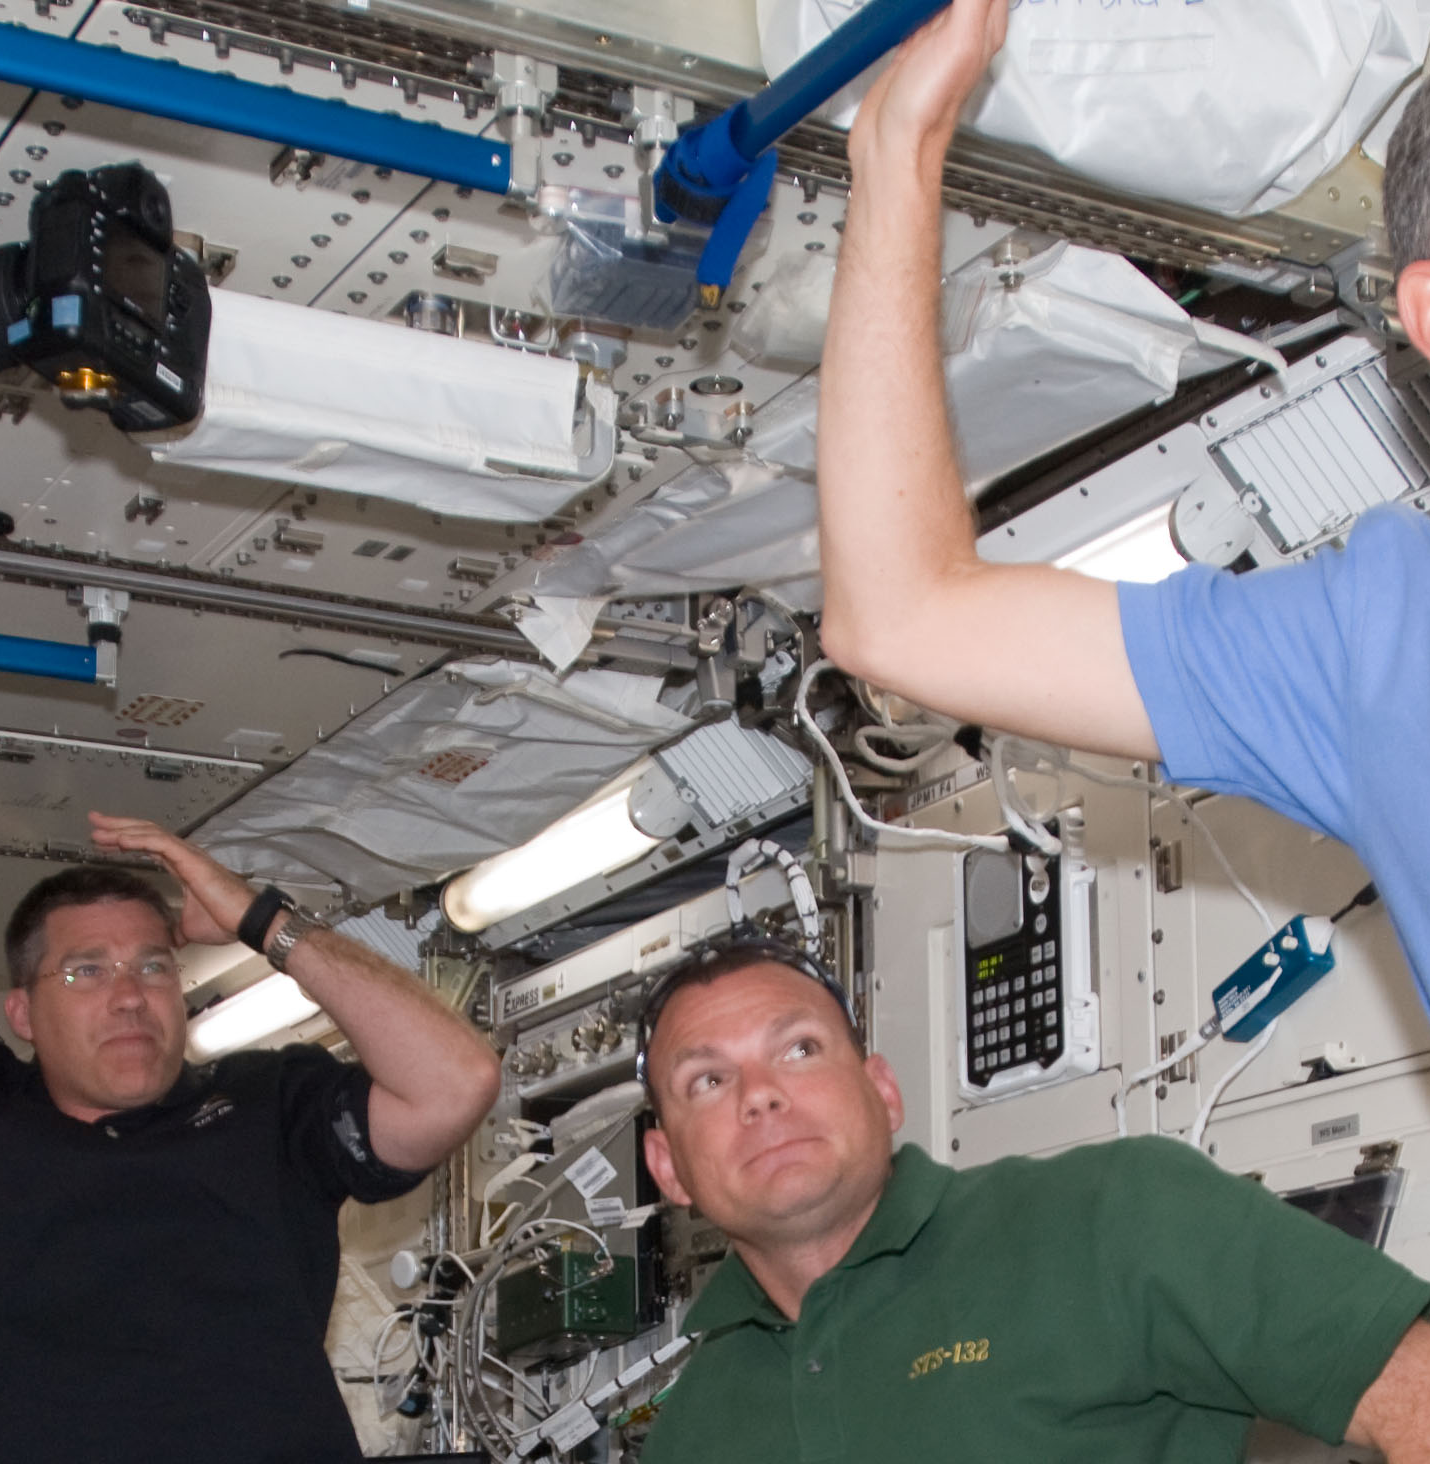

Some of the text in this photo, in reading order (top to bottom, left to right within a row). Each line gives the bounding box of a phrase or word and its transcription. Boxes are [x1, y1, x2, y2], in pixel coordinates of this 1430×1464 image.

[911, 787, 936, 809] JPM1
[939, 778, 952, 797] F4
[557, 971, 564, 991] 4
[908, 1338, 990, 1380] STS-132
